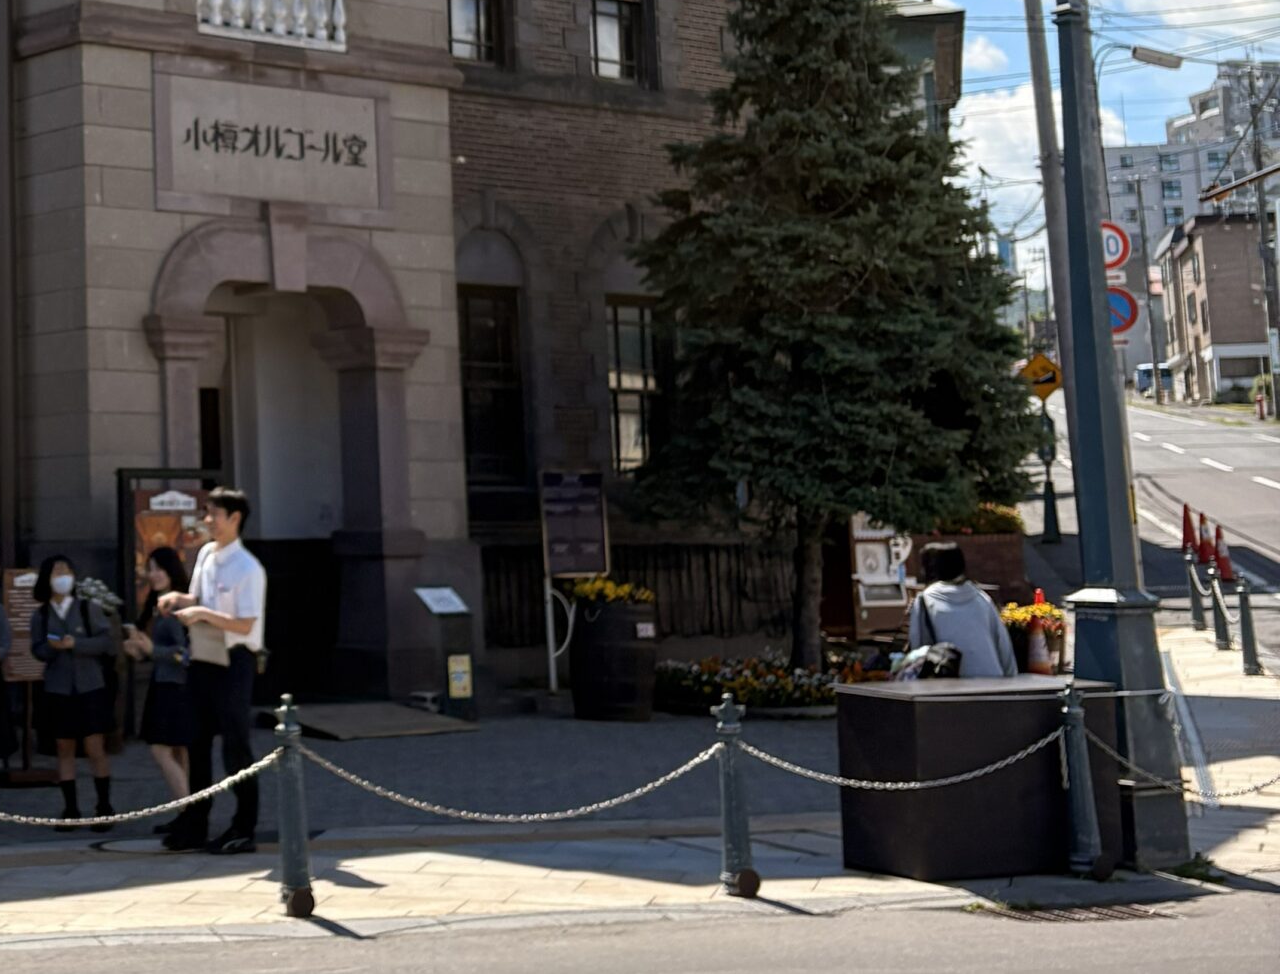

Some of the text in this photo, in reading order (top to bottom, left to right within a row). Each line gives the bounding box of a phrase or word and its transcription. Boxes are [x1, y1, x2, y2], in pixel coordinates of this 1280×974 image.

[183, 117, 368, 168] 小樽オルゴール堂
[1106, 235, 1120, 256] 0
